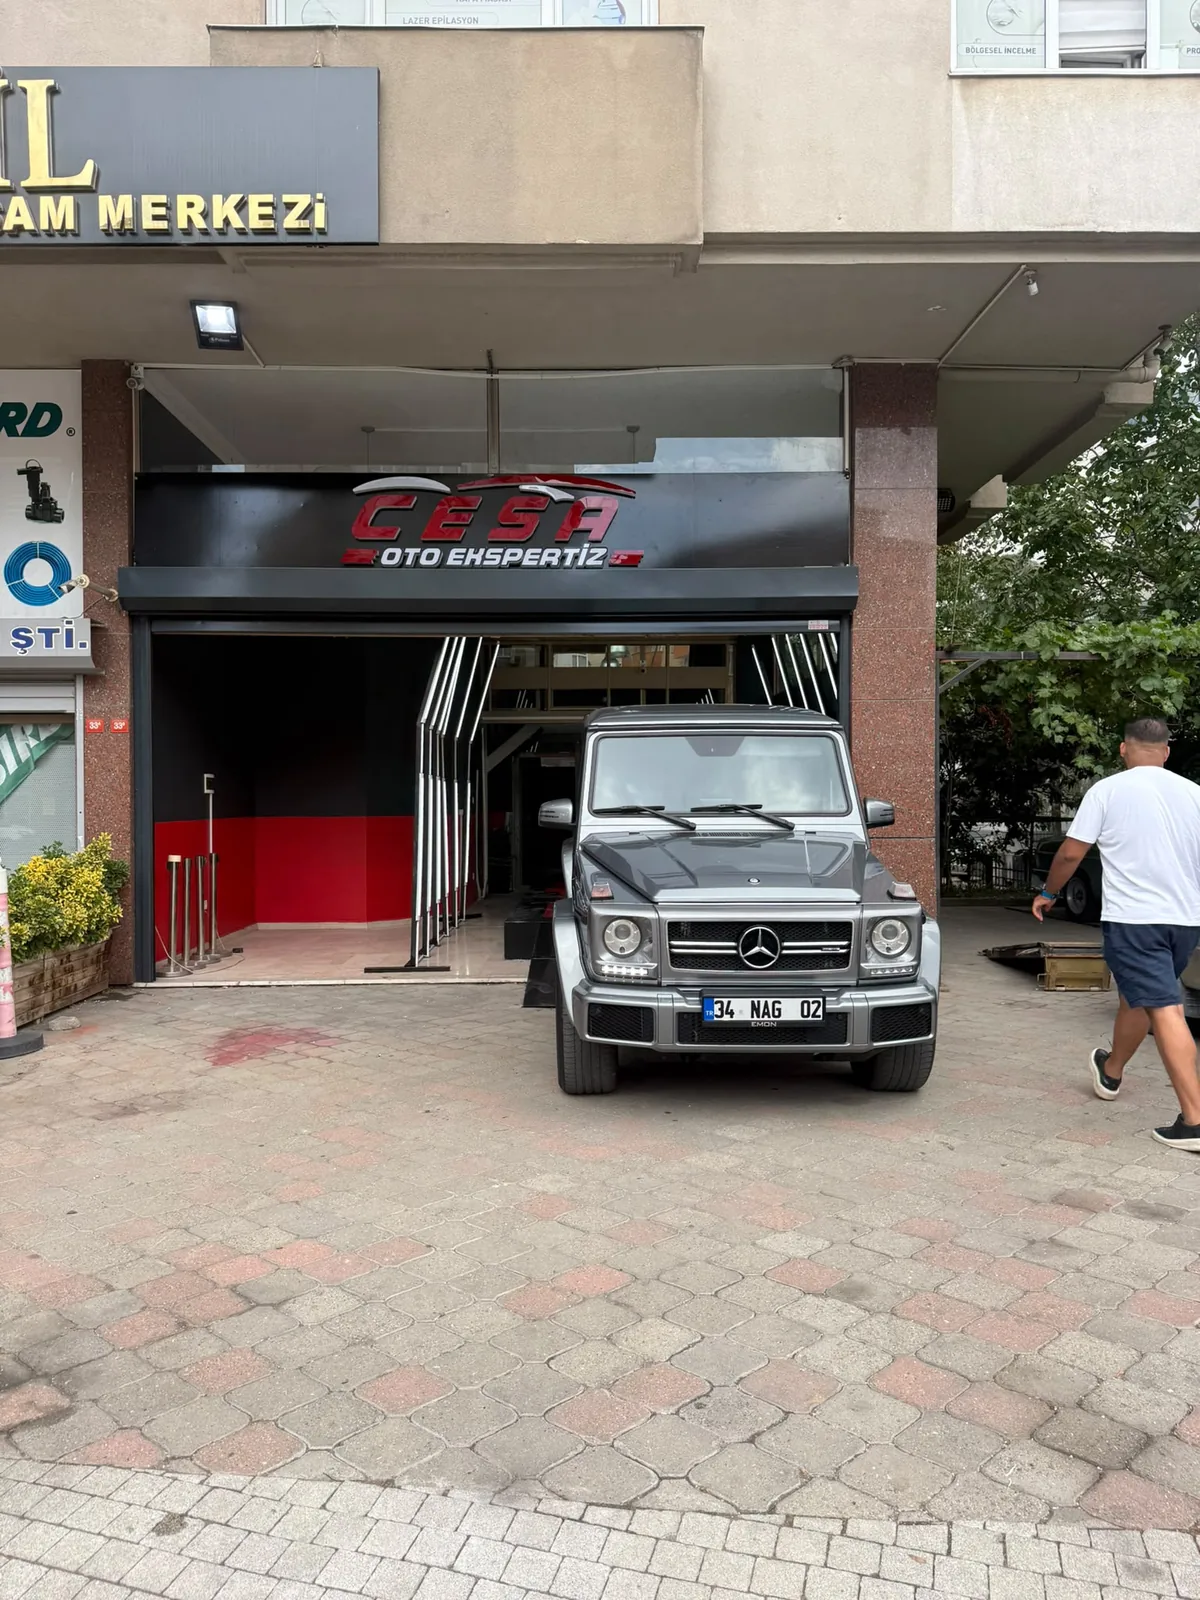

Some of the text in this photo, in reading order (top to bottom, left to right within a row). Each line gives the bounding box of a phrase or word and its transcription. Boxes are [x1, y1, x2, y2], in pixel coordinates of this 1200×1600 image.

[402, 14, 479, 25] LAZER EPİLASYON
[965, 46, 1037, 55] BÖLGESEL İNCELME
[0, 67, 98, 190] L
[0, 194, 78, 233] AM
[351, 495, 619, 542] CESA
[380, 543, 609, 568] OTO EKSPERTİZ
[10, 619, 88, 655] ŞTİ.
[714, 1000, 735, 1019] 34
[750, 1000, 782, 1019] NAG
[800, 1000, 822, 1019] 02
